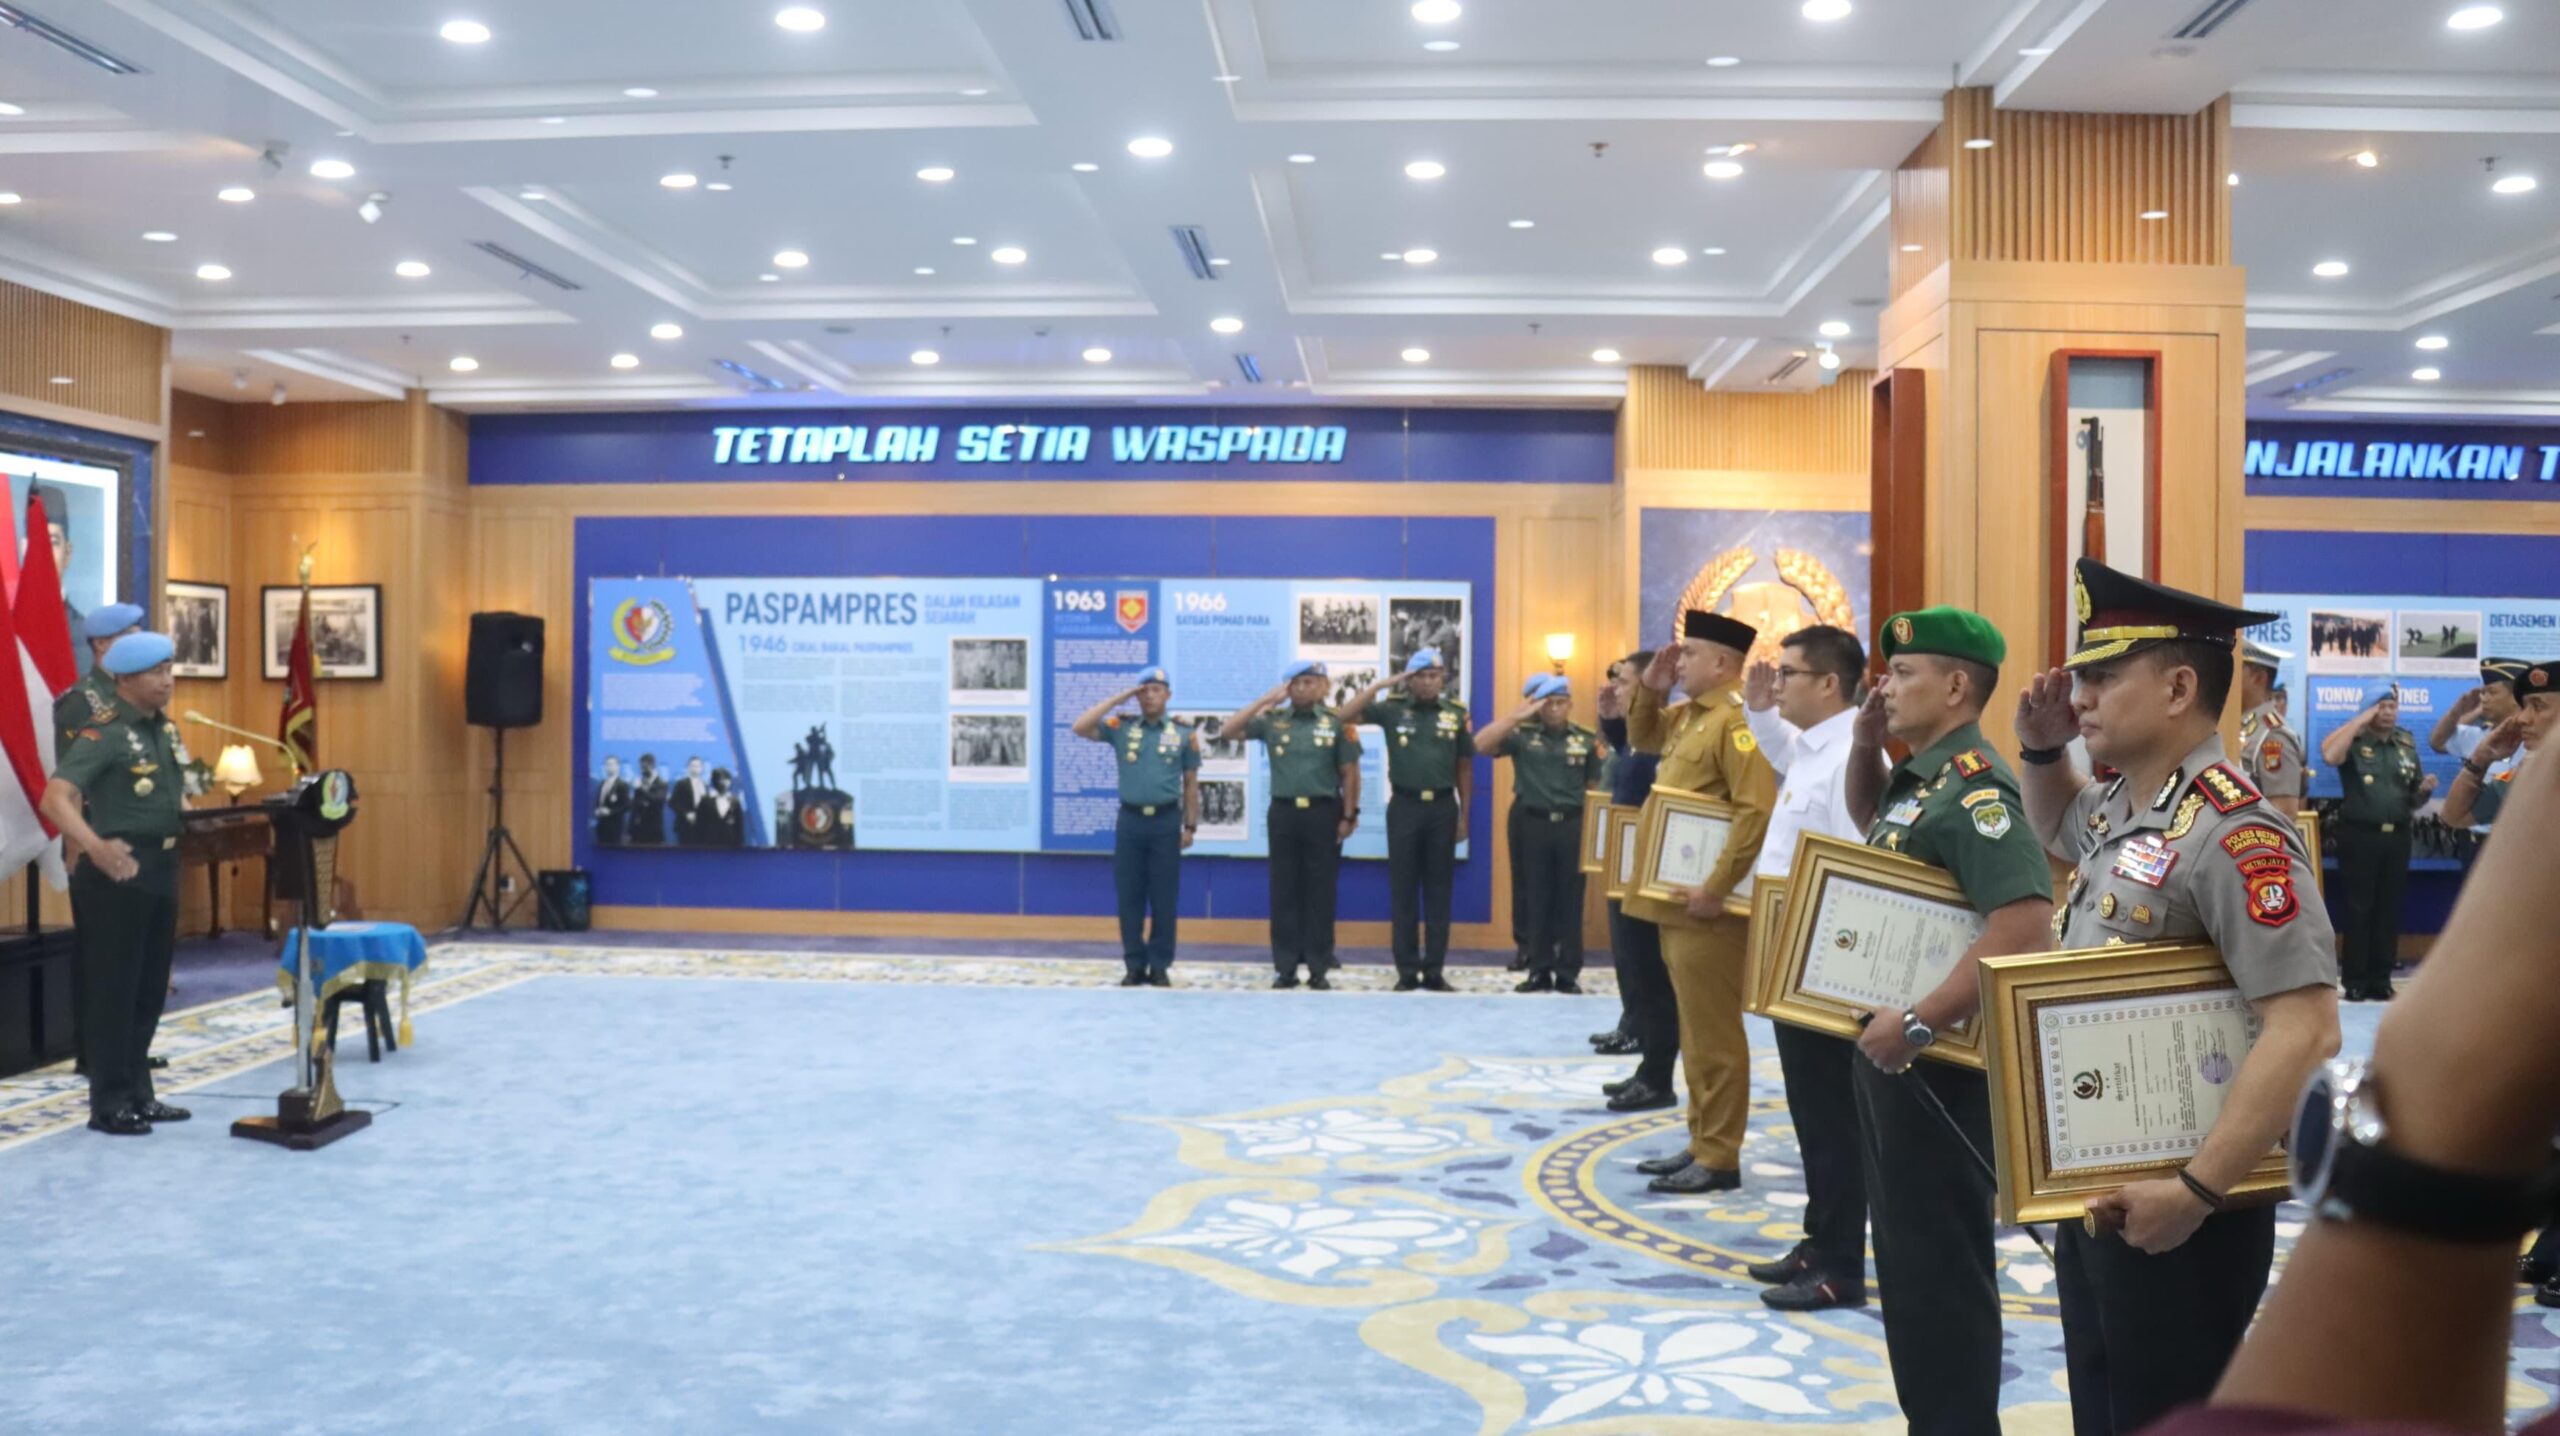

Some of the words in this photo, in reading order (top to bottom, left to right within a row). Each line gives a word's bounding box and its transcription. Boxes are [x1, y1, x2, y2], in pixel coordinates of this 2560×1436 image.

[713, 426, 940, 464] TETAPLAH
[956, 426, 1091, 463] SETIA
[1111, 426, 1348, 463] WASPADA
[725, 592, 918, 625] PASPAMPRES
[1053, 590, 1107, 612] 1963
[1173, 591, 1228, 613] 1966
[2489, 613, 2557, 628] DETASEMEN
[738, 634, 787, 653] 1946
[2226, 829, 2255, 847] POLRES
[2243, 859, 2267, 871] METRO
[2267, 858, 2286, 866] JAYA
